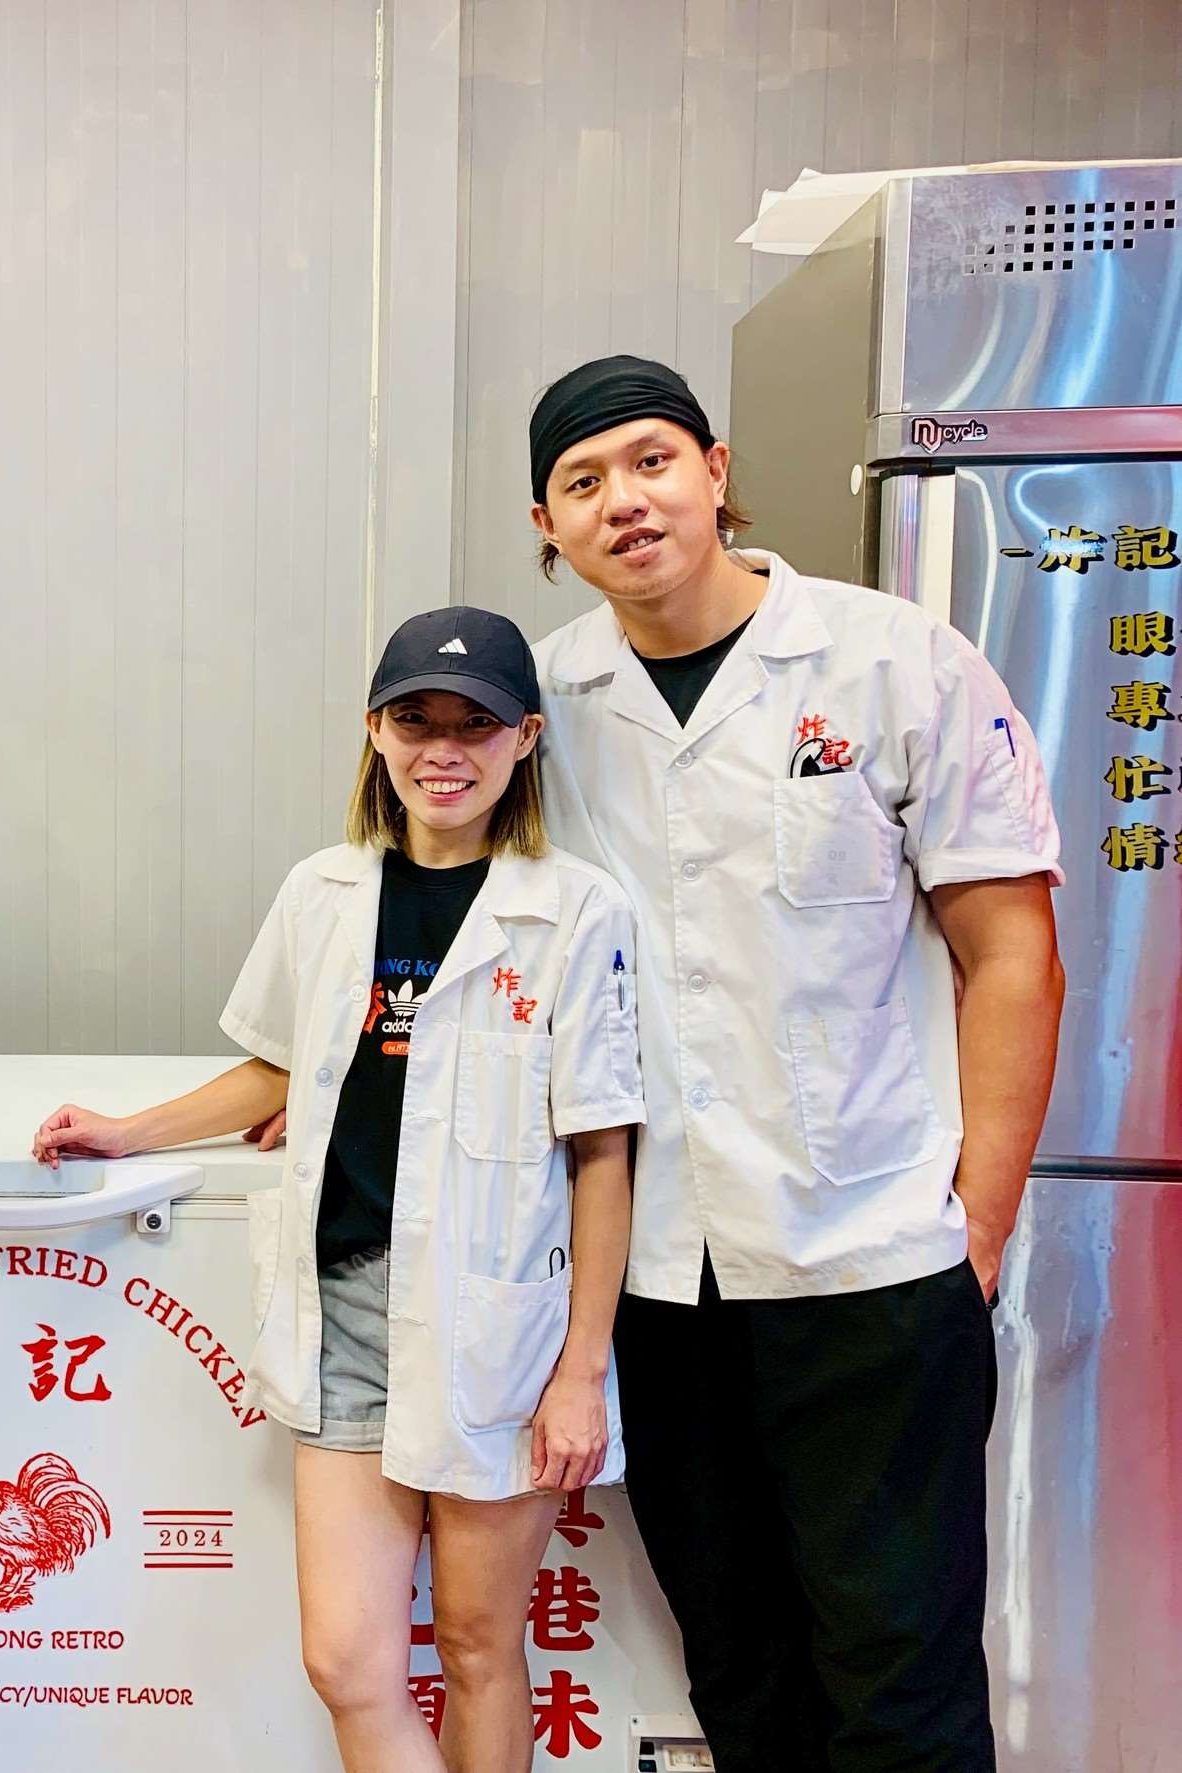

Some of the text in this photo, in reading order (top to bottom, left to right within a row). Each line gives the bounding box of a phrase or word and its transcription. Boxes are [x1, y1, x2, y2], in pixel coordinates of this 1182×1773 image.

[795, 714, 853, 767] 炸記
[1101, 611, 1177, 872] 眼專忙情
[492, 967, 538, 1025] 炸記
[159, 1528, 225, 1547] 2024
[51, 1630, 124, 1650] RETRO
[116, 1687, 194, 1706] FLAVOR
